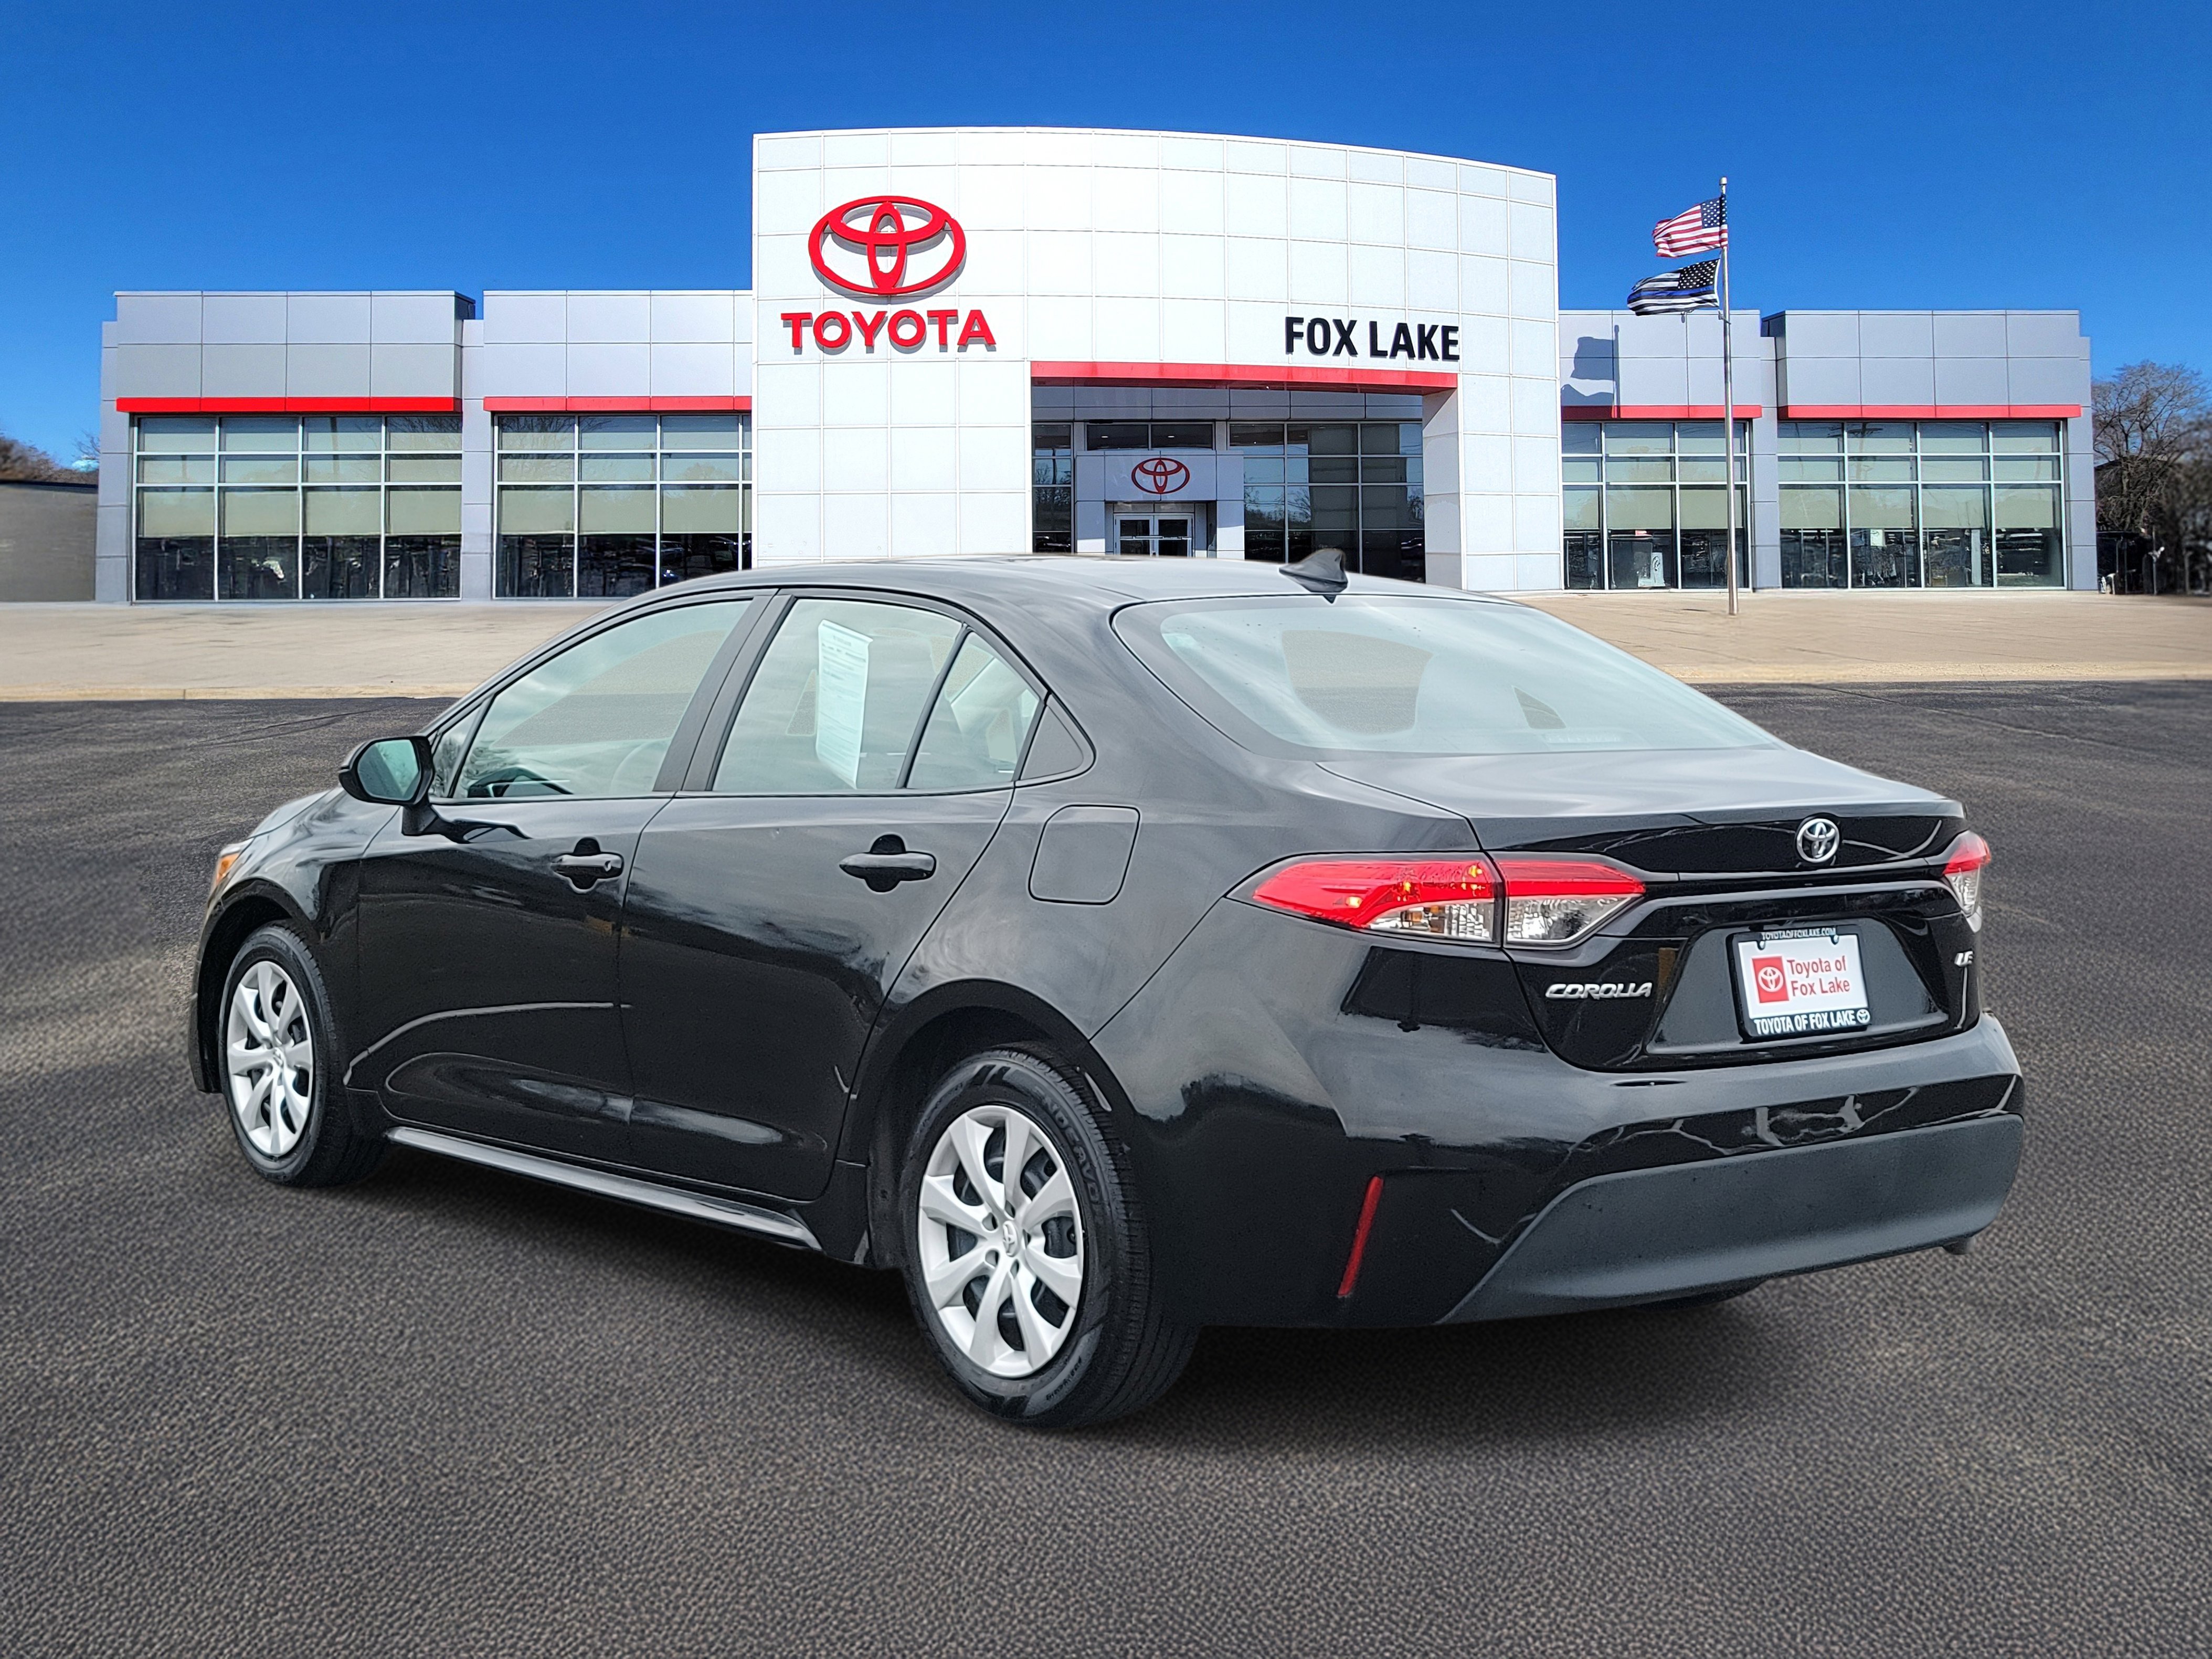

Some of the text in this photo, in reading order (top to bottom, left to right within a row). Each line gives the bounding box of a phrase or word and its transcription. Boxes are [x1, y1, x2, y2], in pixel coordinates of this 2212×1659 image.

[781, 309, 997, 353] TOYOTA
[1285, 316, 1460, 361] FOX LAKE
[1786, 955, 1847, 978] Toyota of
[1545, 982, 1653, 1000] COROLLA
[1791, 977, 1850, 997] Fox Lake
[1754, 1010, 1856, 1034] TOYOTA OF FOX LAKE
